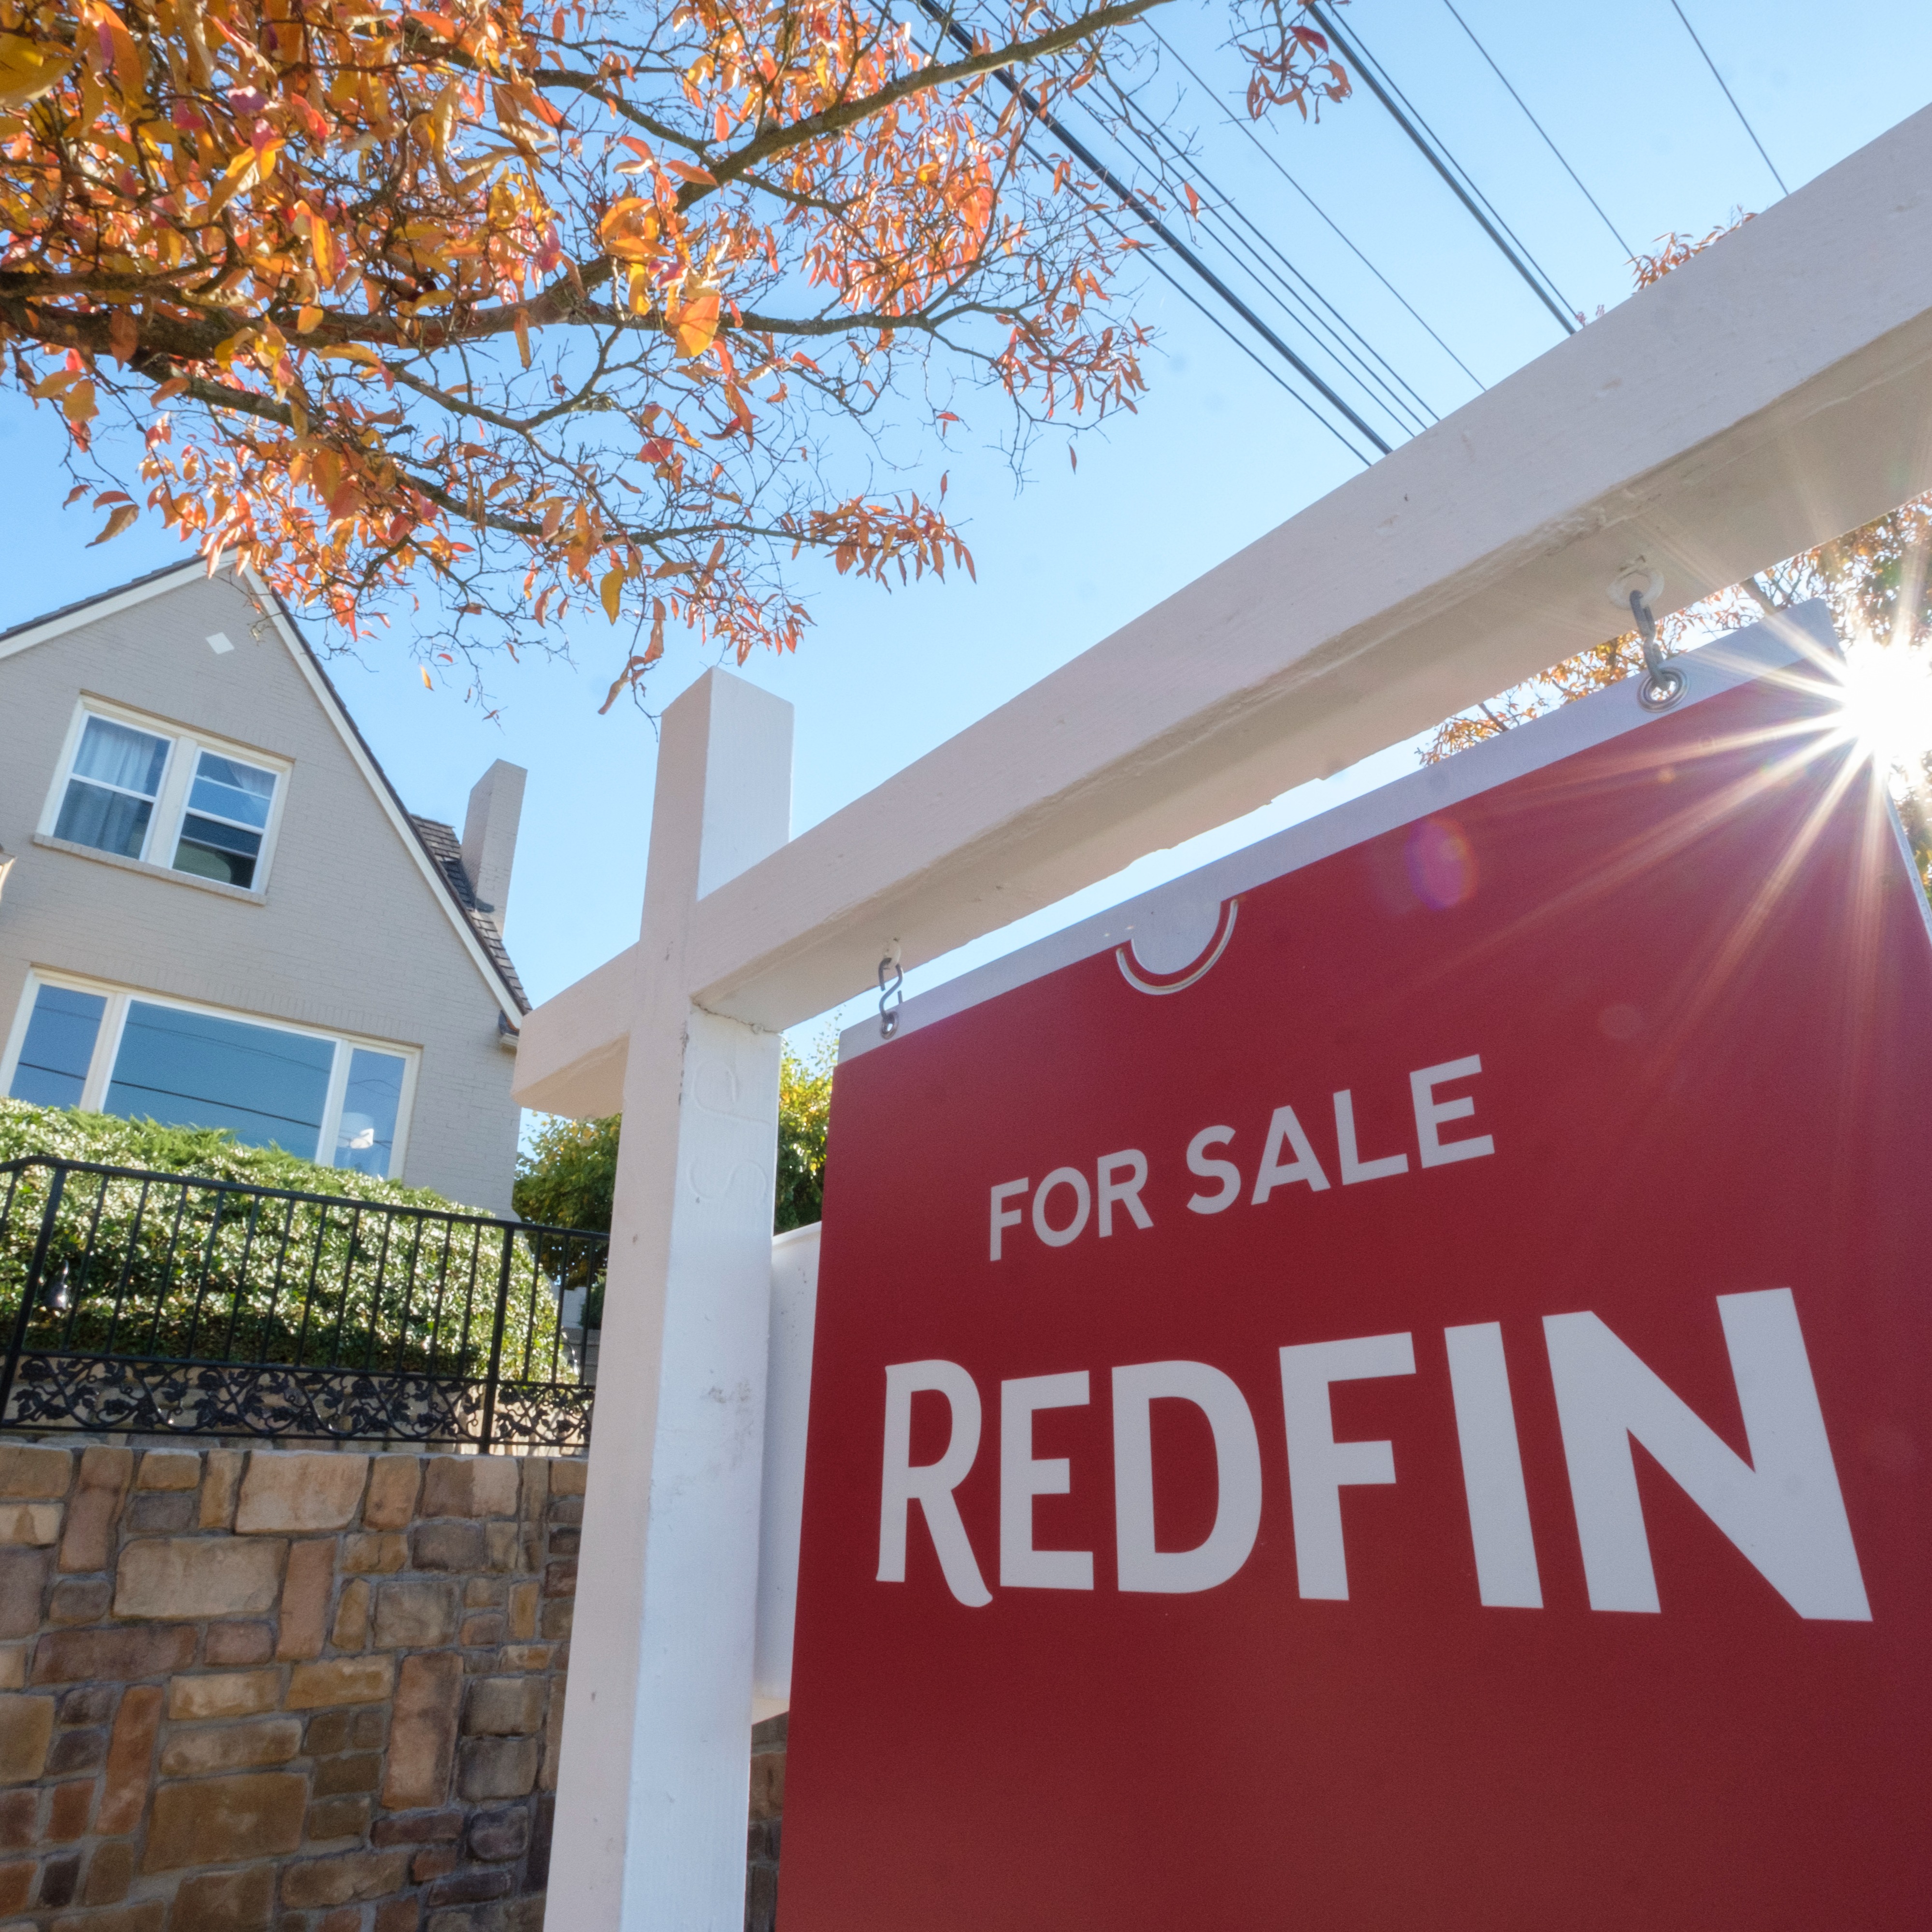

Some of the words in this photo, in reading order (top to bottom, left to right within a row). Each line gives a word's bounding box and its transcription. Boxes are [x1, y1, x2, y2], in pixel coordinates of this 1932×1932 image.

[990, 1149, 1153, 1261] FOR
[1187, 1054, 1495, 1214] SALE
[876, 1288, 1873, 1621] REDFIN
